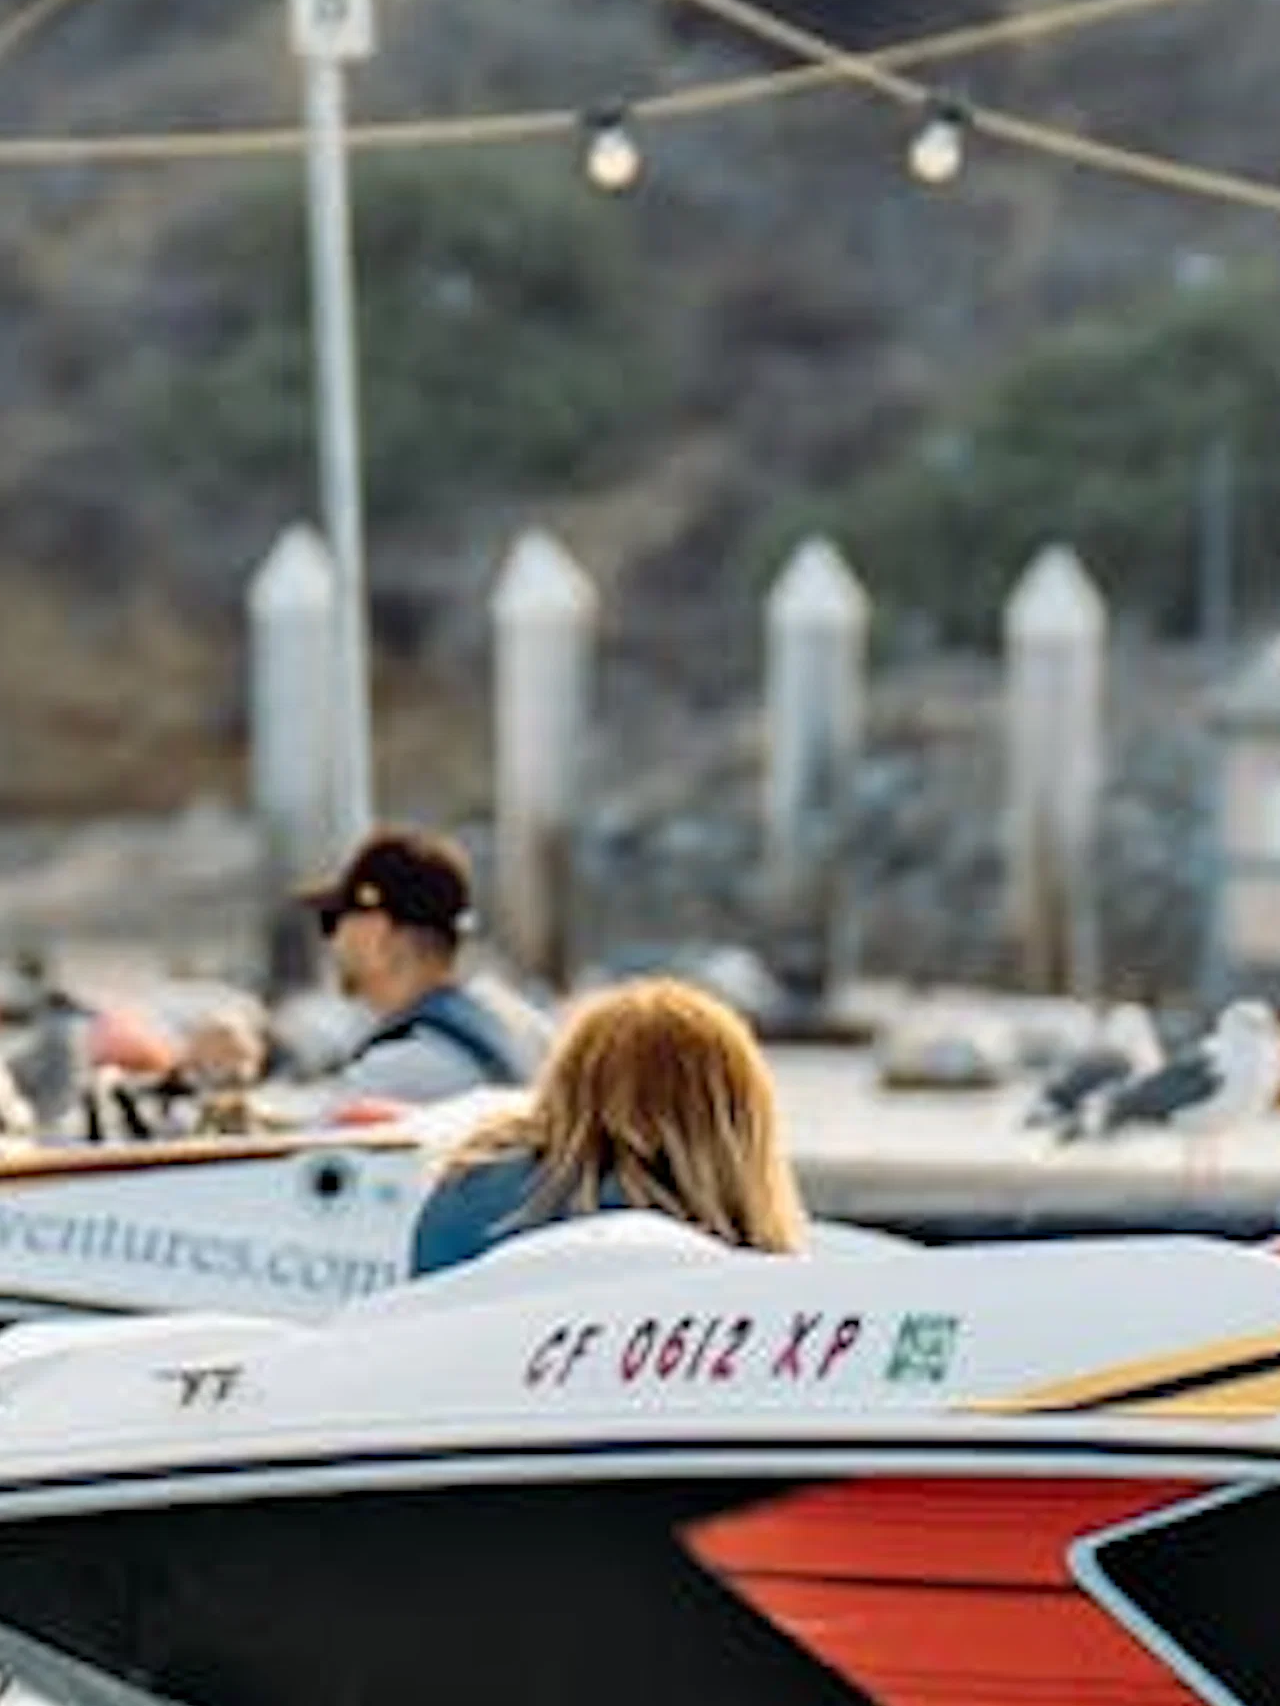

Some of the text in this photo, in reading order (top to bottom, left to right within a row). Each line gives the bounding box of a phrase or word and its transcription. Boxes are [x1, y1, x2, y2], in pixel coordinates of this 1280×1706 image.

[524, 1325, 601, 1386] CF
[621, 1318, 752, 1381] 0612
[771, 1311, 862, 1380] XP
